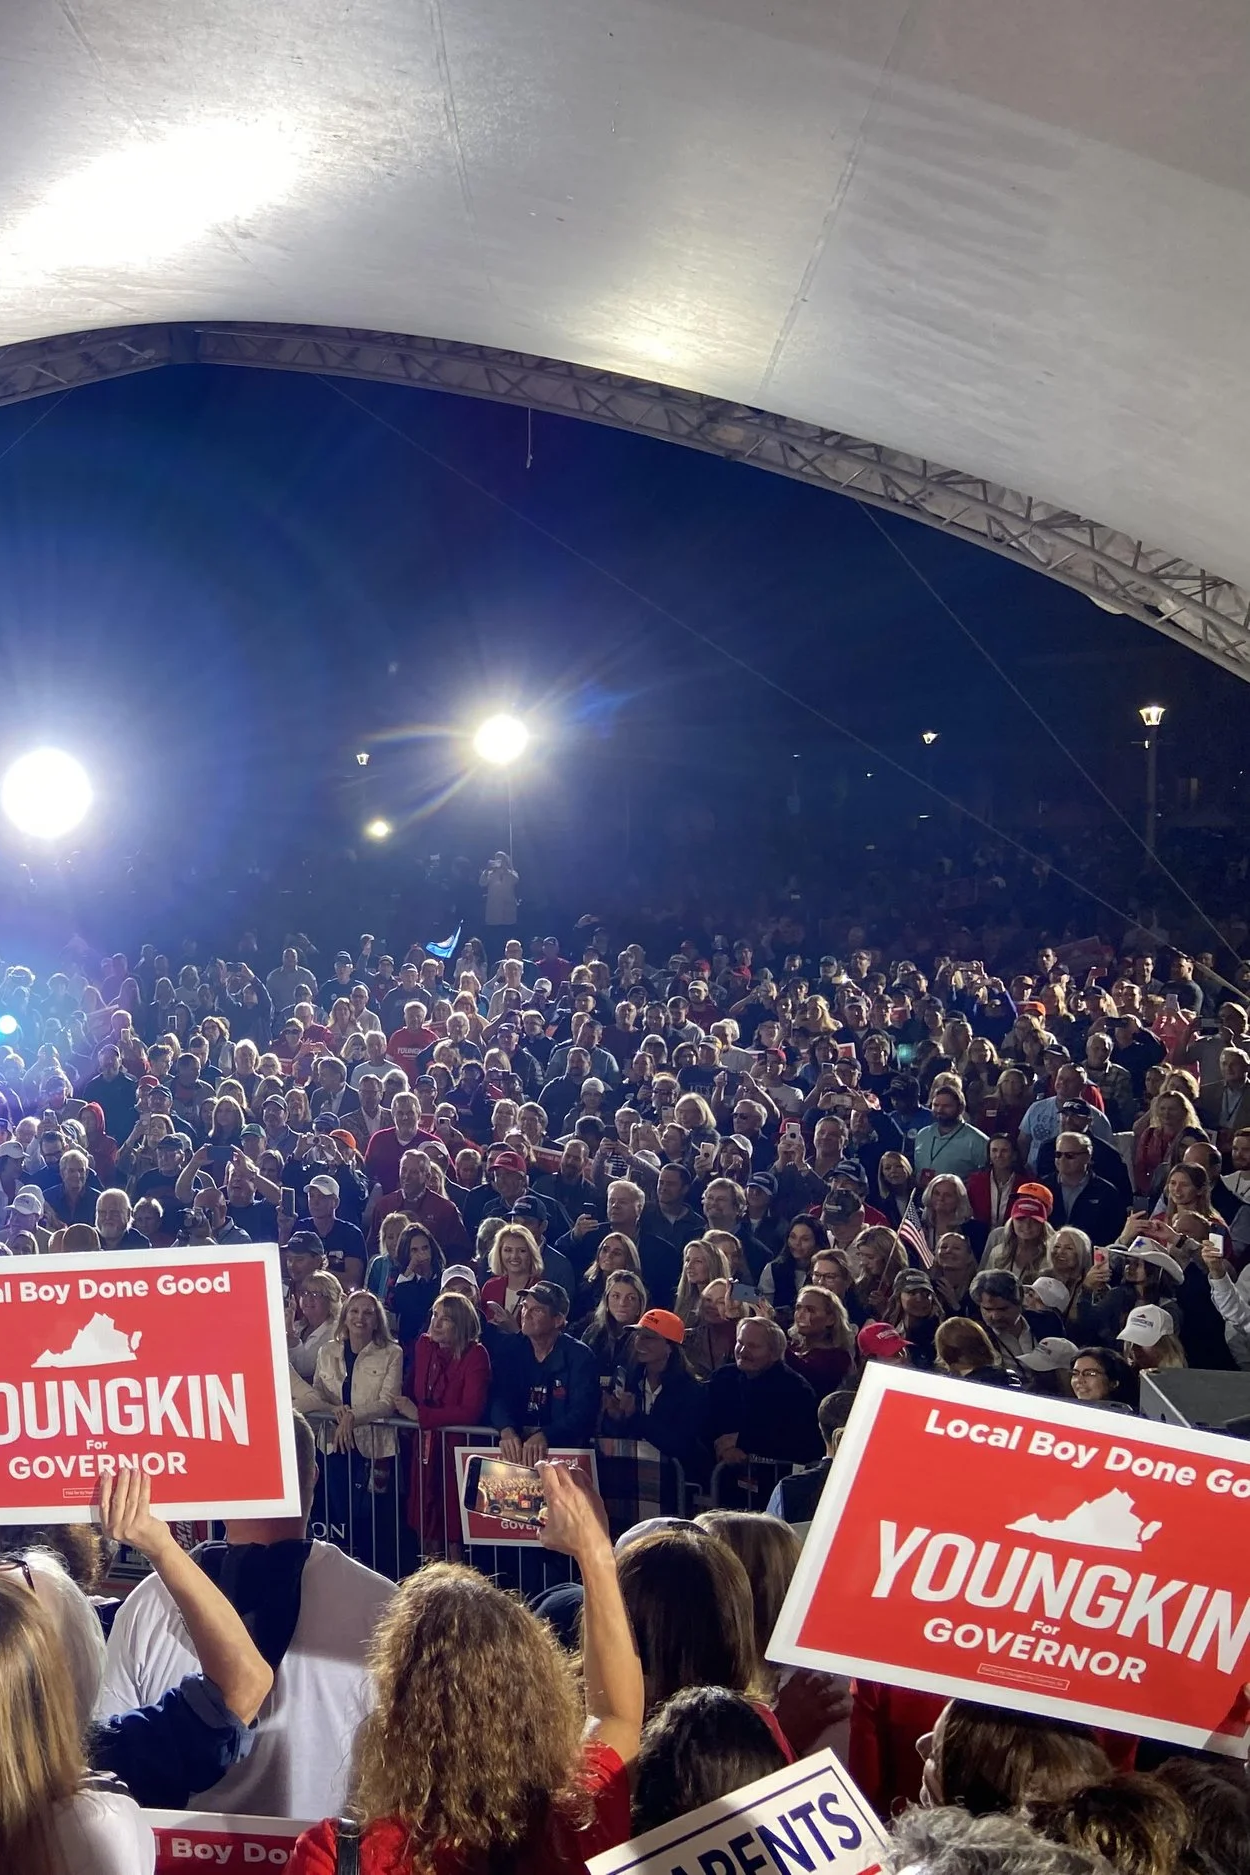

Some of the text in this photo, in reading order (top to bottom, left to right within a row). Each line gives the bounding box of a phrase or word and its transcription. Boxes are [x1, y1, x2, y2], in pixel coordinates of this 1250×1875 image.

[20, 1281, 70, 1305] Boy
[79, 1277, 148, 1300] Done
[157, 1271, 230, 1295] Good
[86, 1439, 108, 1451] For
[924, 1409, 1250, 1498] Local Boy Done Go
[8, 1452, 188, 1480] GOVERNOR
[501, 1520, 542, 1531] GOVE
[871, 1520, 1250, 1675] YOUNGKIN
[1031, 1620, 1060, 1636] For
[923, 1617, 1147, 1684] GOVERNOR
[171, 1837, 233, 1865] Boy
[244, 1842, 295, 1865] Do
